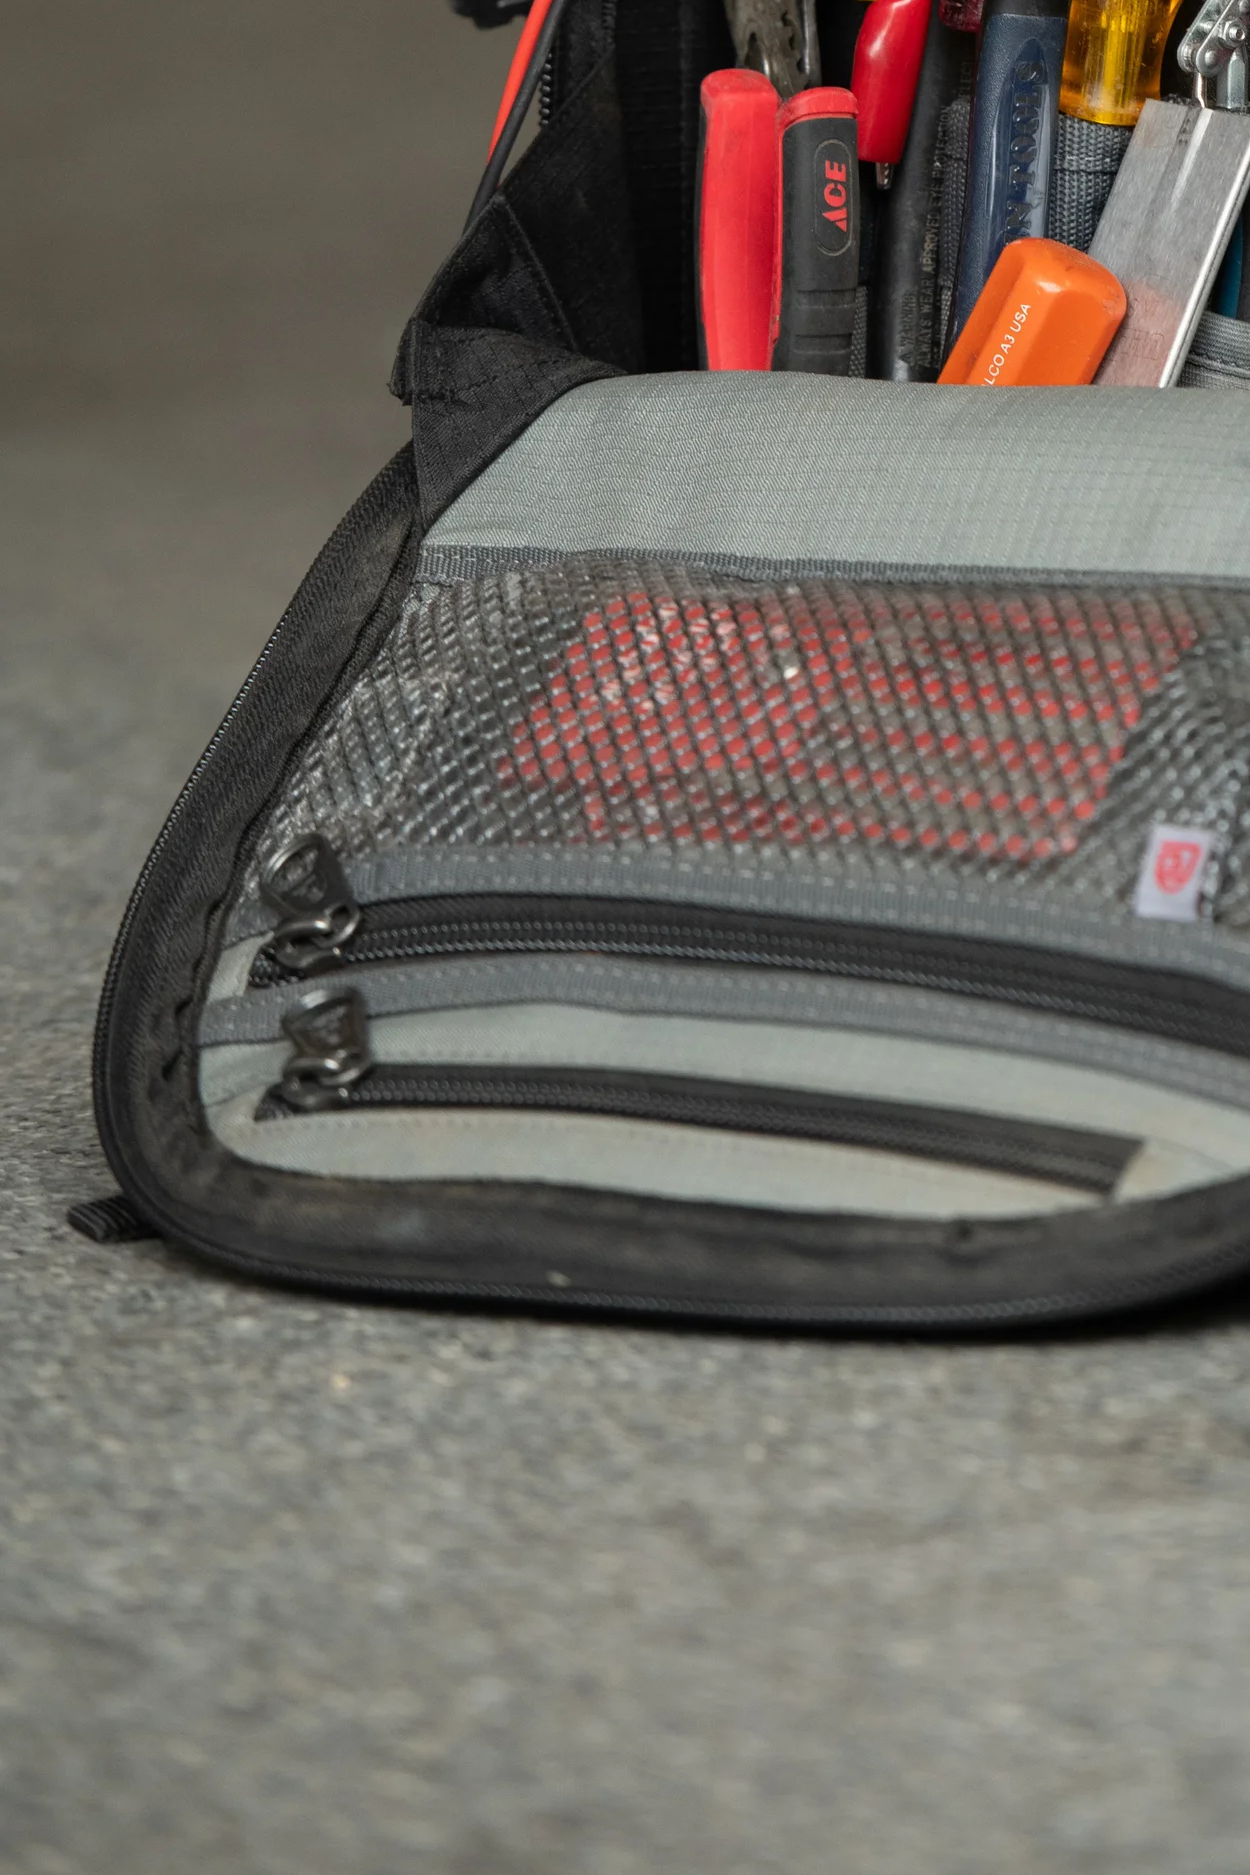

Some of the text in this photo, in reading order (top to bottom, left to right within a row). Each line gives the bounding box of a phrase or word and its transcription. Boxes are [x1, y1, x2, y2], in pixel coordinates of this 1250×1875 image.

[1007, 60, 1048, 190] TOOLS
[822, 159, 848, 233] ACE
[922, 212, 940, 273] APPROVED
[920, 278, 934, 313] WEAR
[917, 317, 932, 368] ALWAYS
[981, 304, 1031, 386] LCO A3 USA
